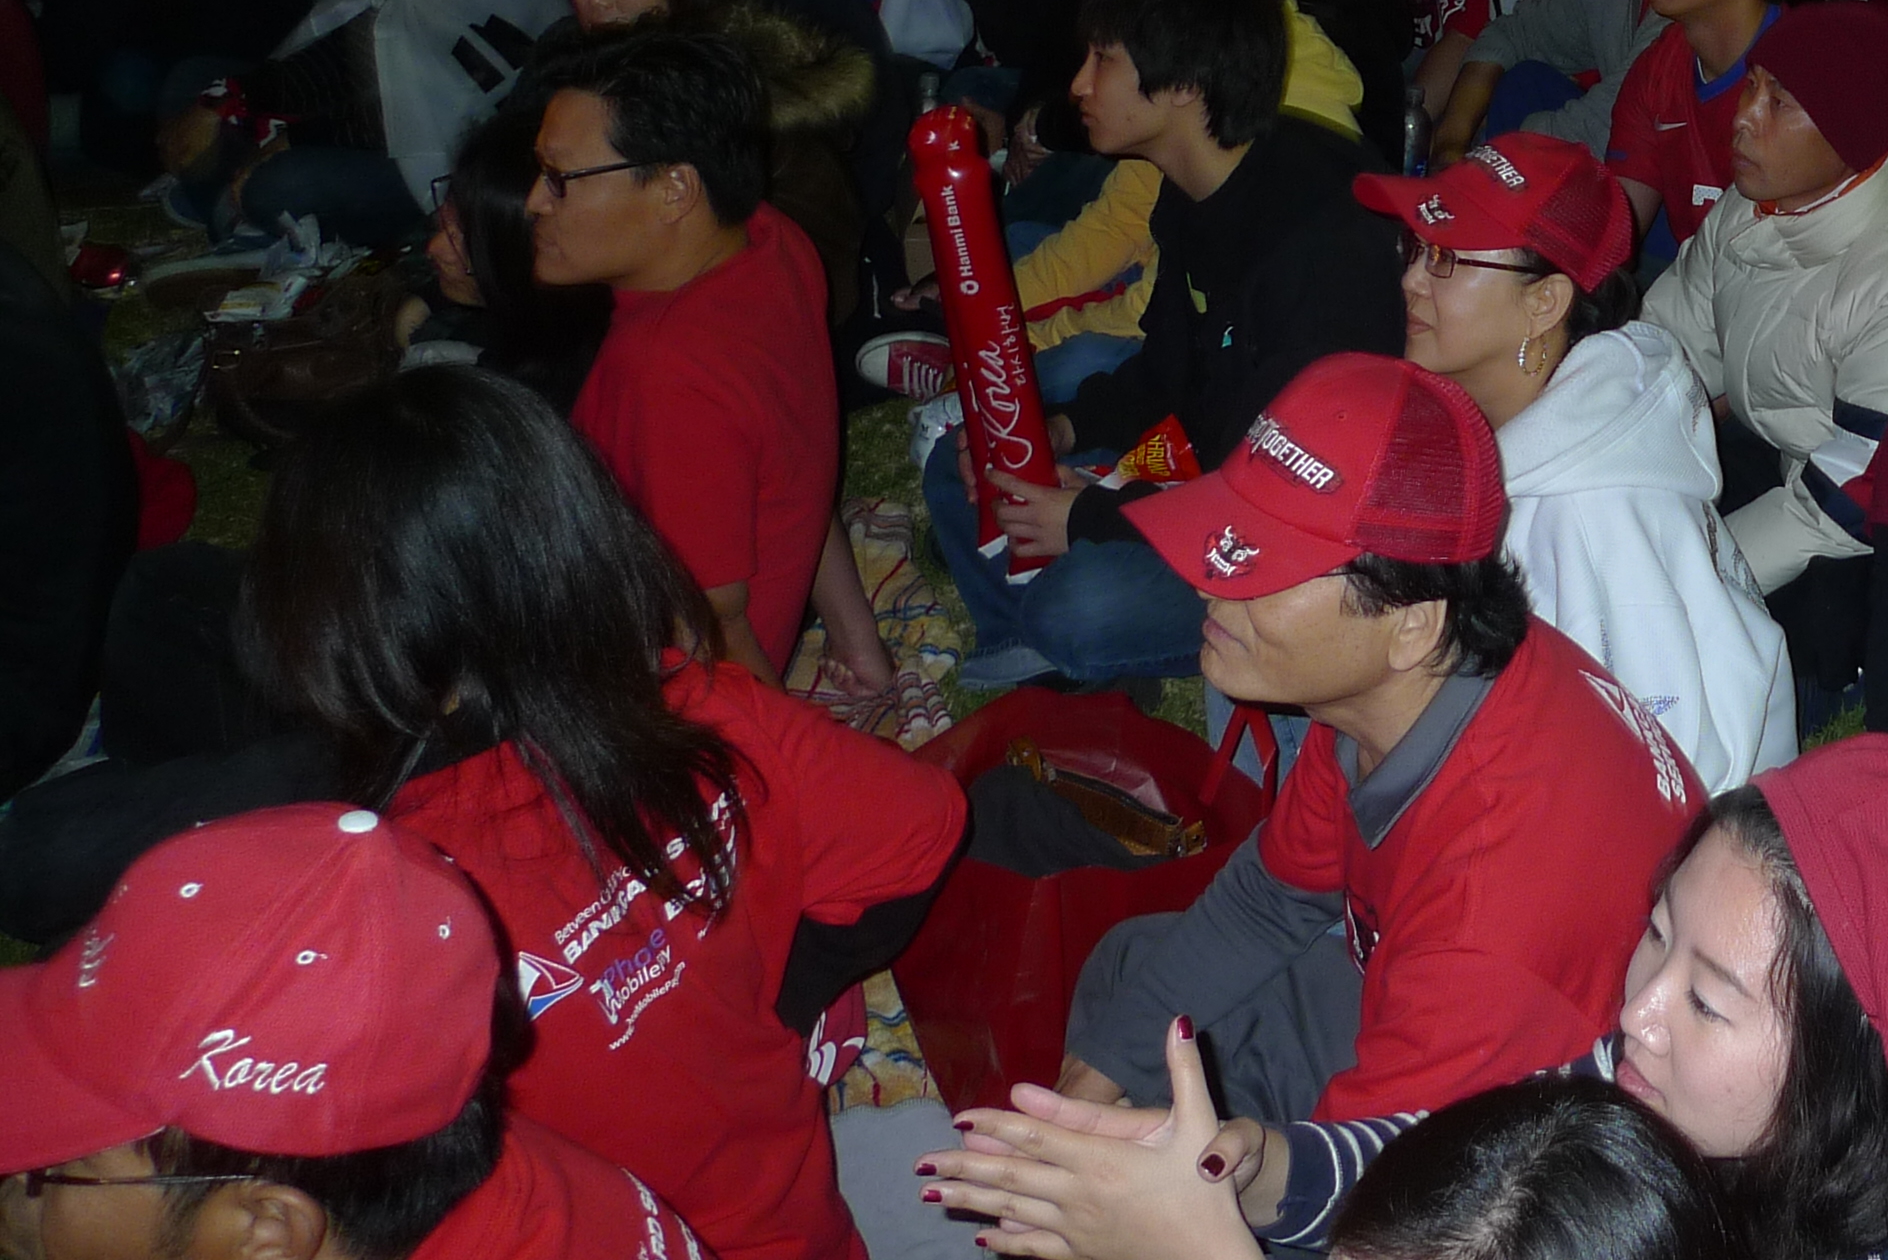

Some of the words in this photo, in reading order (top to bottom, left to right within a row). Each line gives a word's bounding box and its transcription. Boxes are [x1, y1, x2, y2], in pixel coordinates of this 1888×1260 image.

[940, 183, 962, 227] Bank
[950, 227, 974, 277] Hanmi
[977, 340, 1033, 470] Korea
[179, 1028, 328, 1095] Korea
